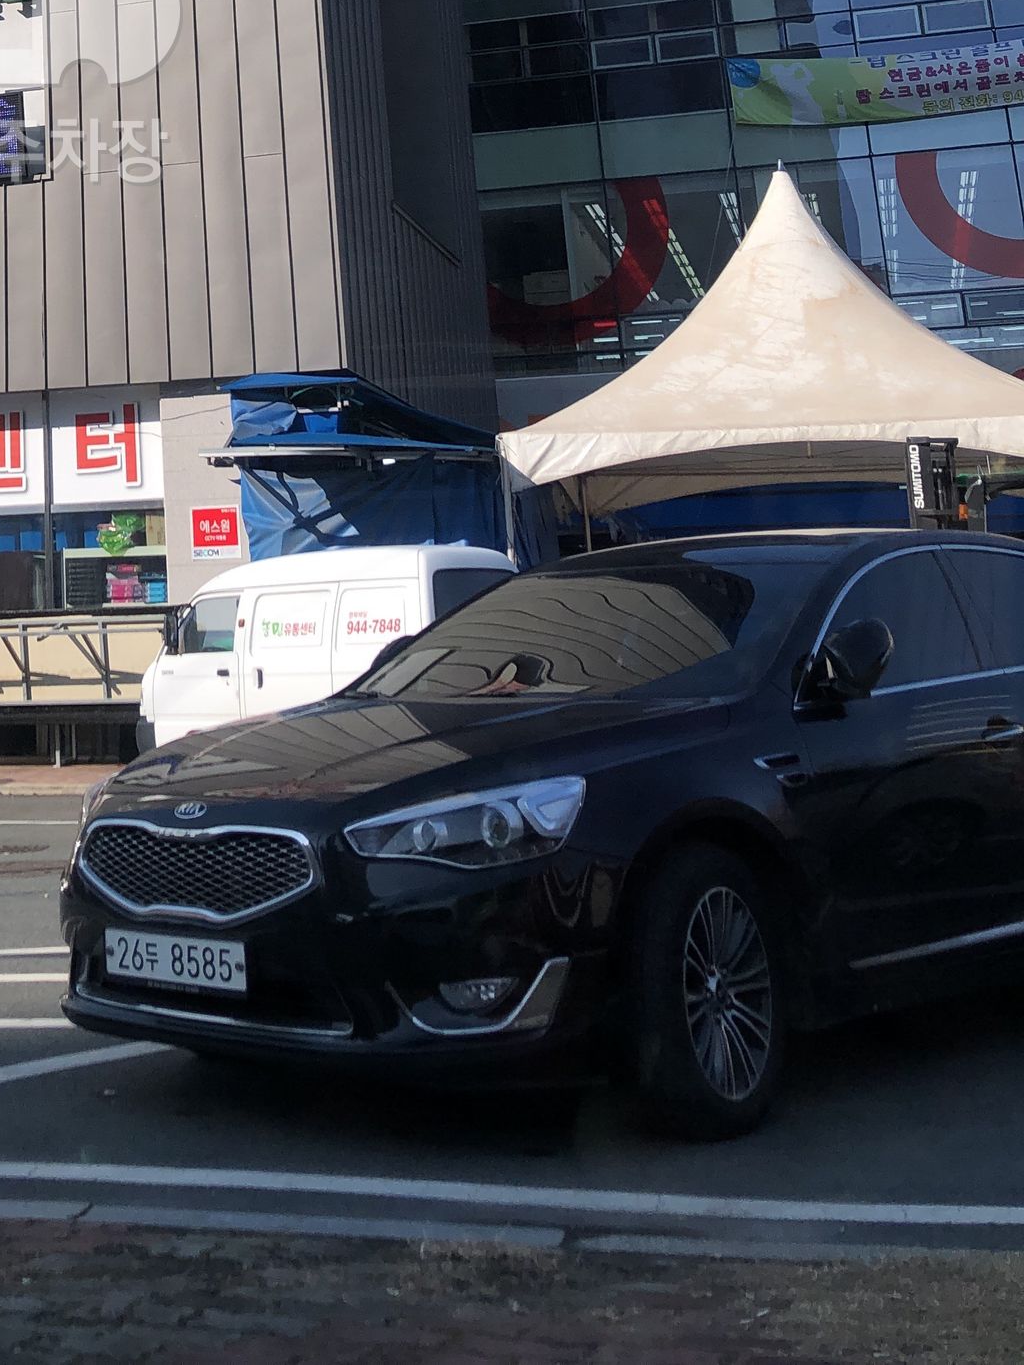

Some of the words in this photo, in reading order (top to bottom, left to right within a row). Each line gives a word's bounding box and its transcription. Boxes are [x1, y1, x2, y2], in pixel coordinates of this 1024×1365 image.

[908, 444, 925, 509] SUMITOMO
[199, 519, 230, 534] 에스원
[117, 936, 159, 972] 26두
[170, 942, 233, 982] 8585
